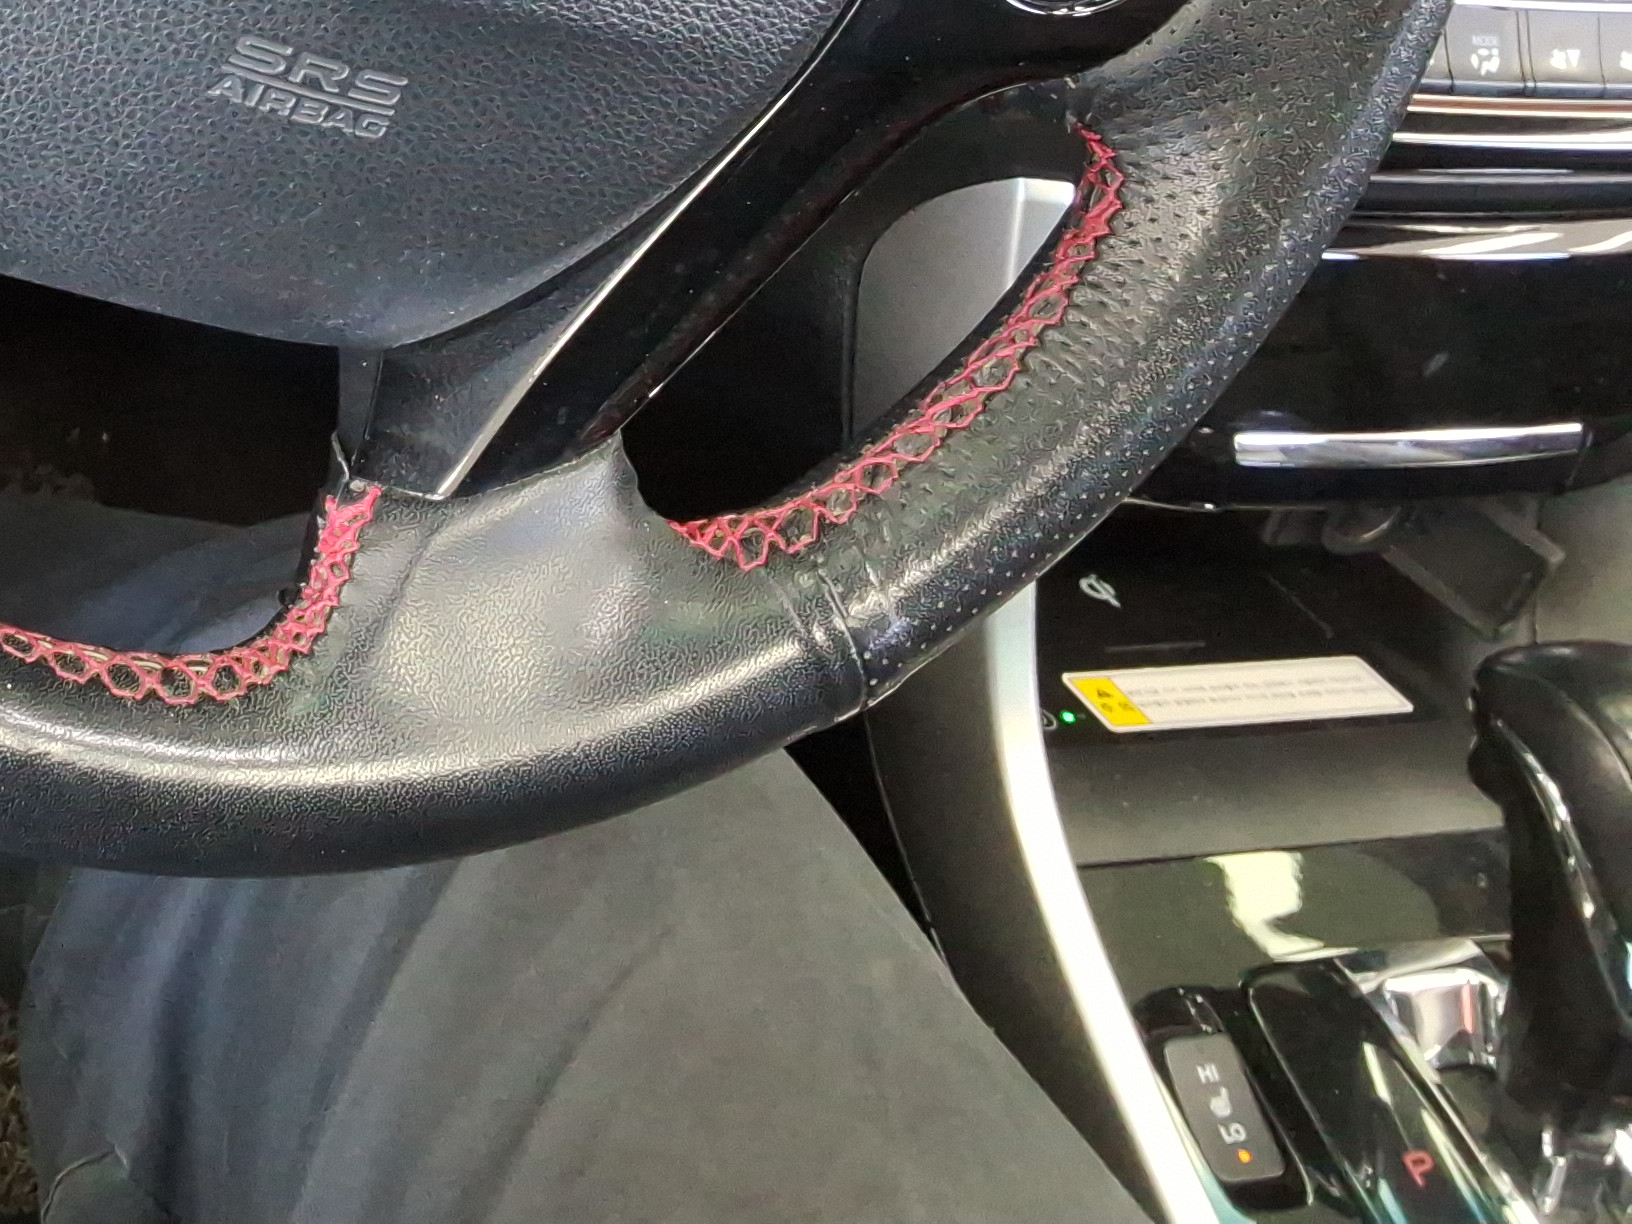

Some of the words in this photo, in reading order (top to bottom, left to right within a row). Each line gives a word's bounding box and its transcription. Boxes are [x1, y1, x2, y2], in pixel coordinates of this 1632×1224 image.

[227, 35, 409, 106] SRS
[208, 76, 390, 139] AIRBAG
[1196, 1063, 1220, 1084] HI
[1402, 1150, 1435, 1187] P
